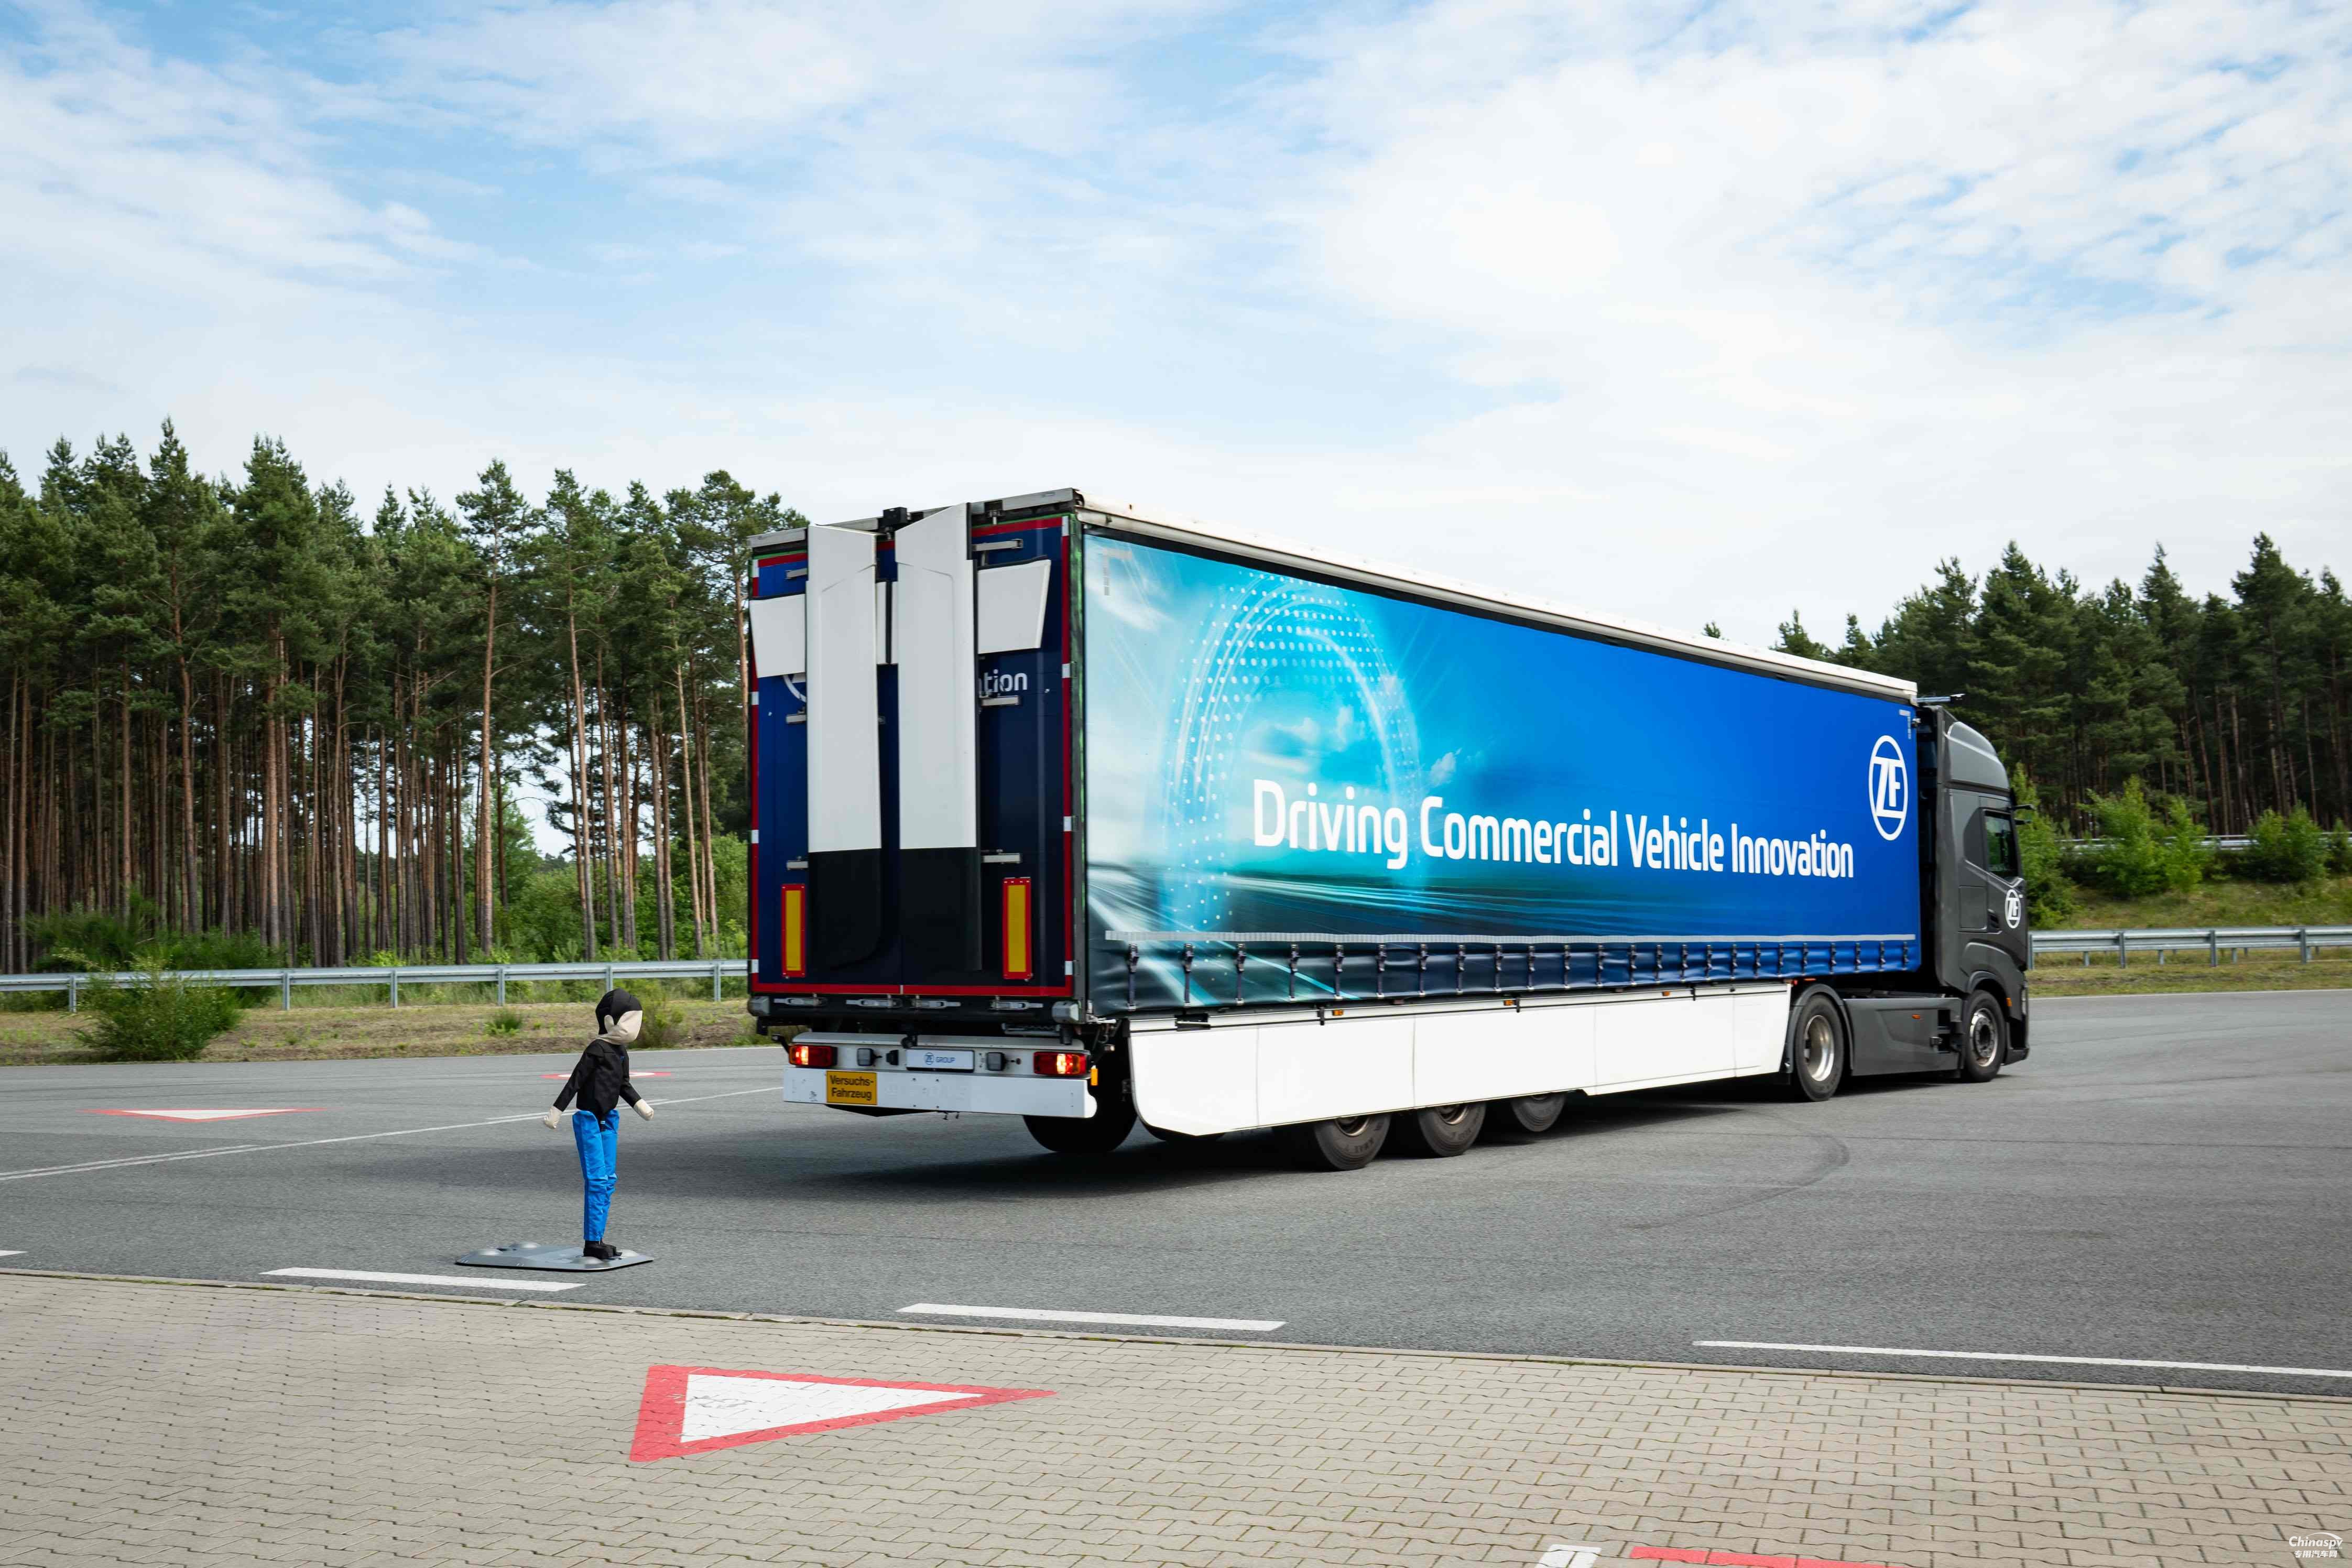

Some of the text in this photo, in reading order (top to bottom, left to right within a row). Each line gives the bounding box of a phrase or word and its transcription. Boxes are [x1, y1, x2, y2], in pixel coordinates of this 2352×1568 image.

[978, 669, 1028, 694] tion
[1869, 755, 1906, 819] ZF
[1254, 779, 1854, 878] Driving Commercial Vehicle Innovation
[2005, 897, 2020, 921] ZF
[830, 1075, 874, 1086] Versuchs-
[832, 1087, 872, 1101] Fahrzeug
